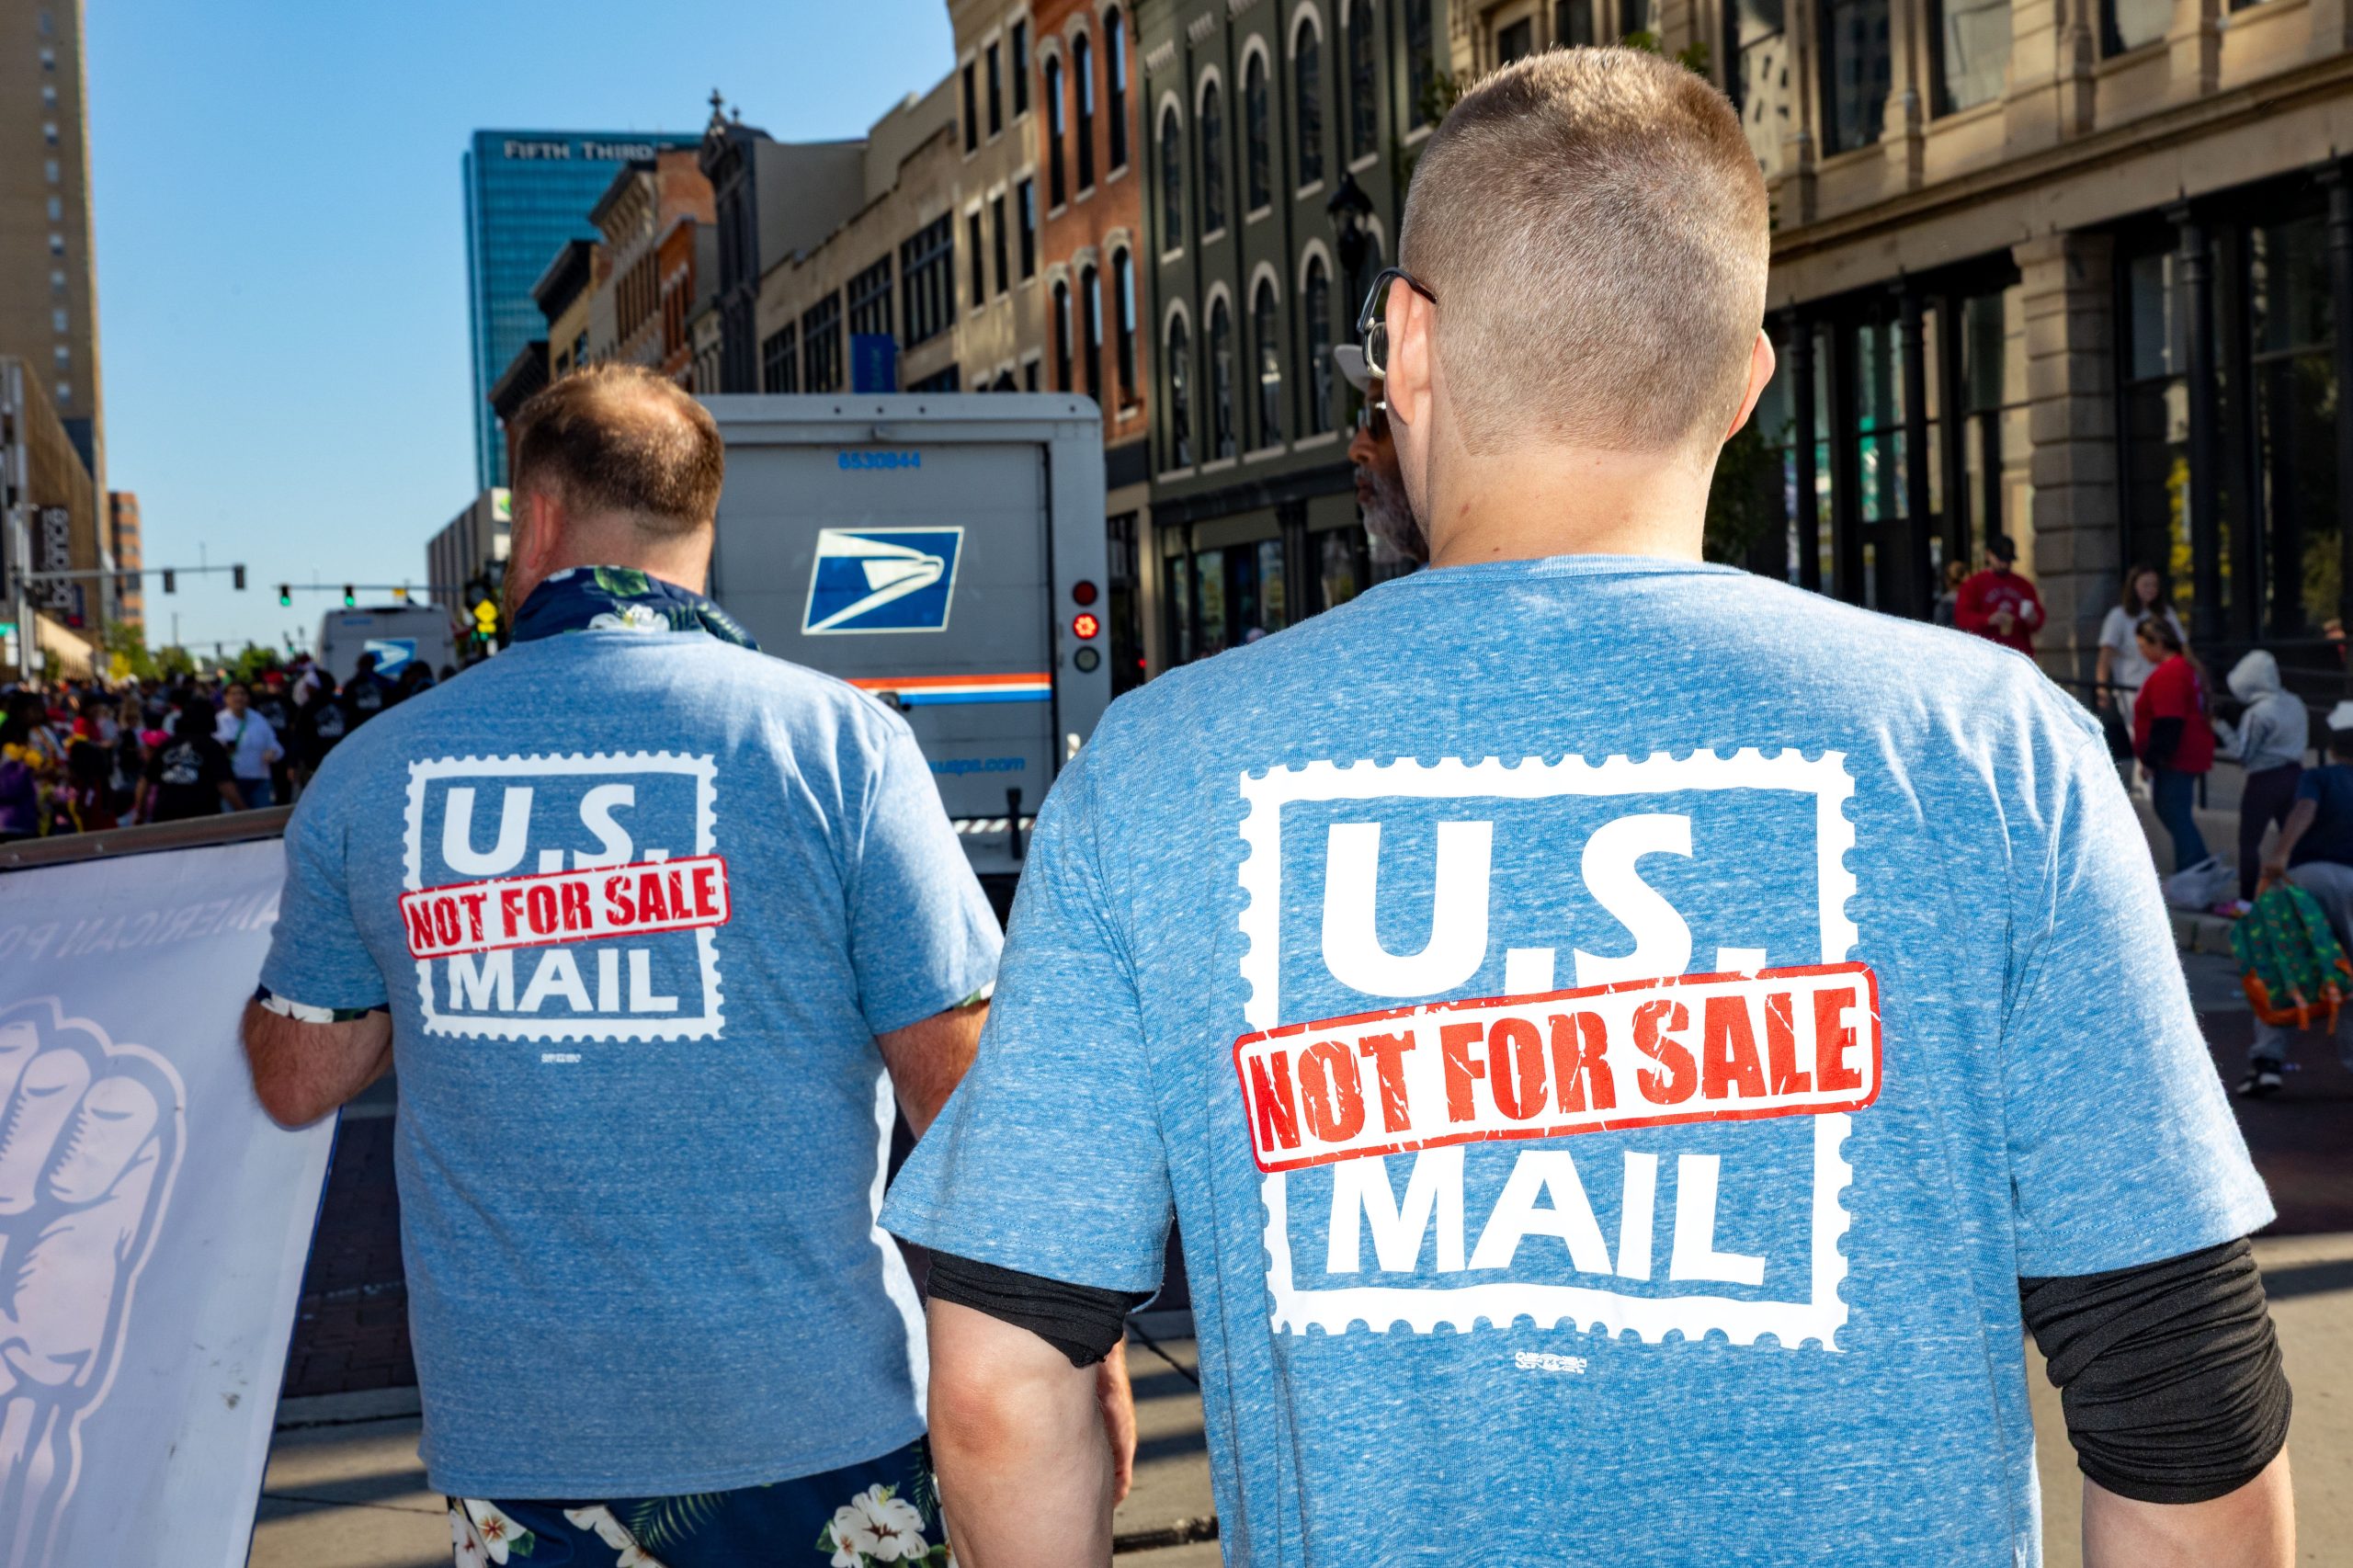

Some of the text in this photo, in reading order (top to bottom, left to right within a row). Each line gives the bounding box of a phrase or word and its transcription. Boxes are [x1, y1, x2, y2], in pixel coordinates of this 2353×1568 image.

[504, 140, 654, 161] FIFTH THIRD
[41, 507, 71, 608] baance
[442, 784, 669, 876] U.S.
[408, 867, 721, 950] NOT FOR SALE
[1322, 813, 1767, 998] U.S.
[449, 949, 678, 1012] MAIL
[1247, 985, 1864, 1153] NOT FOR SALE
[1325, 1150, 1767, 1286] MAIL
